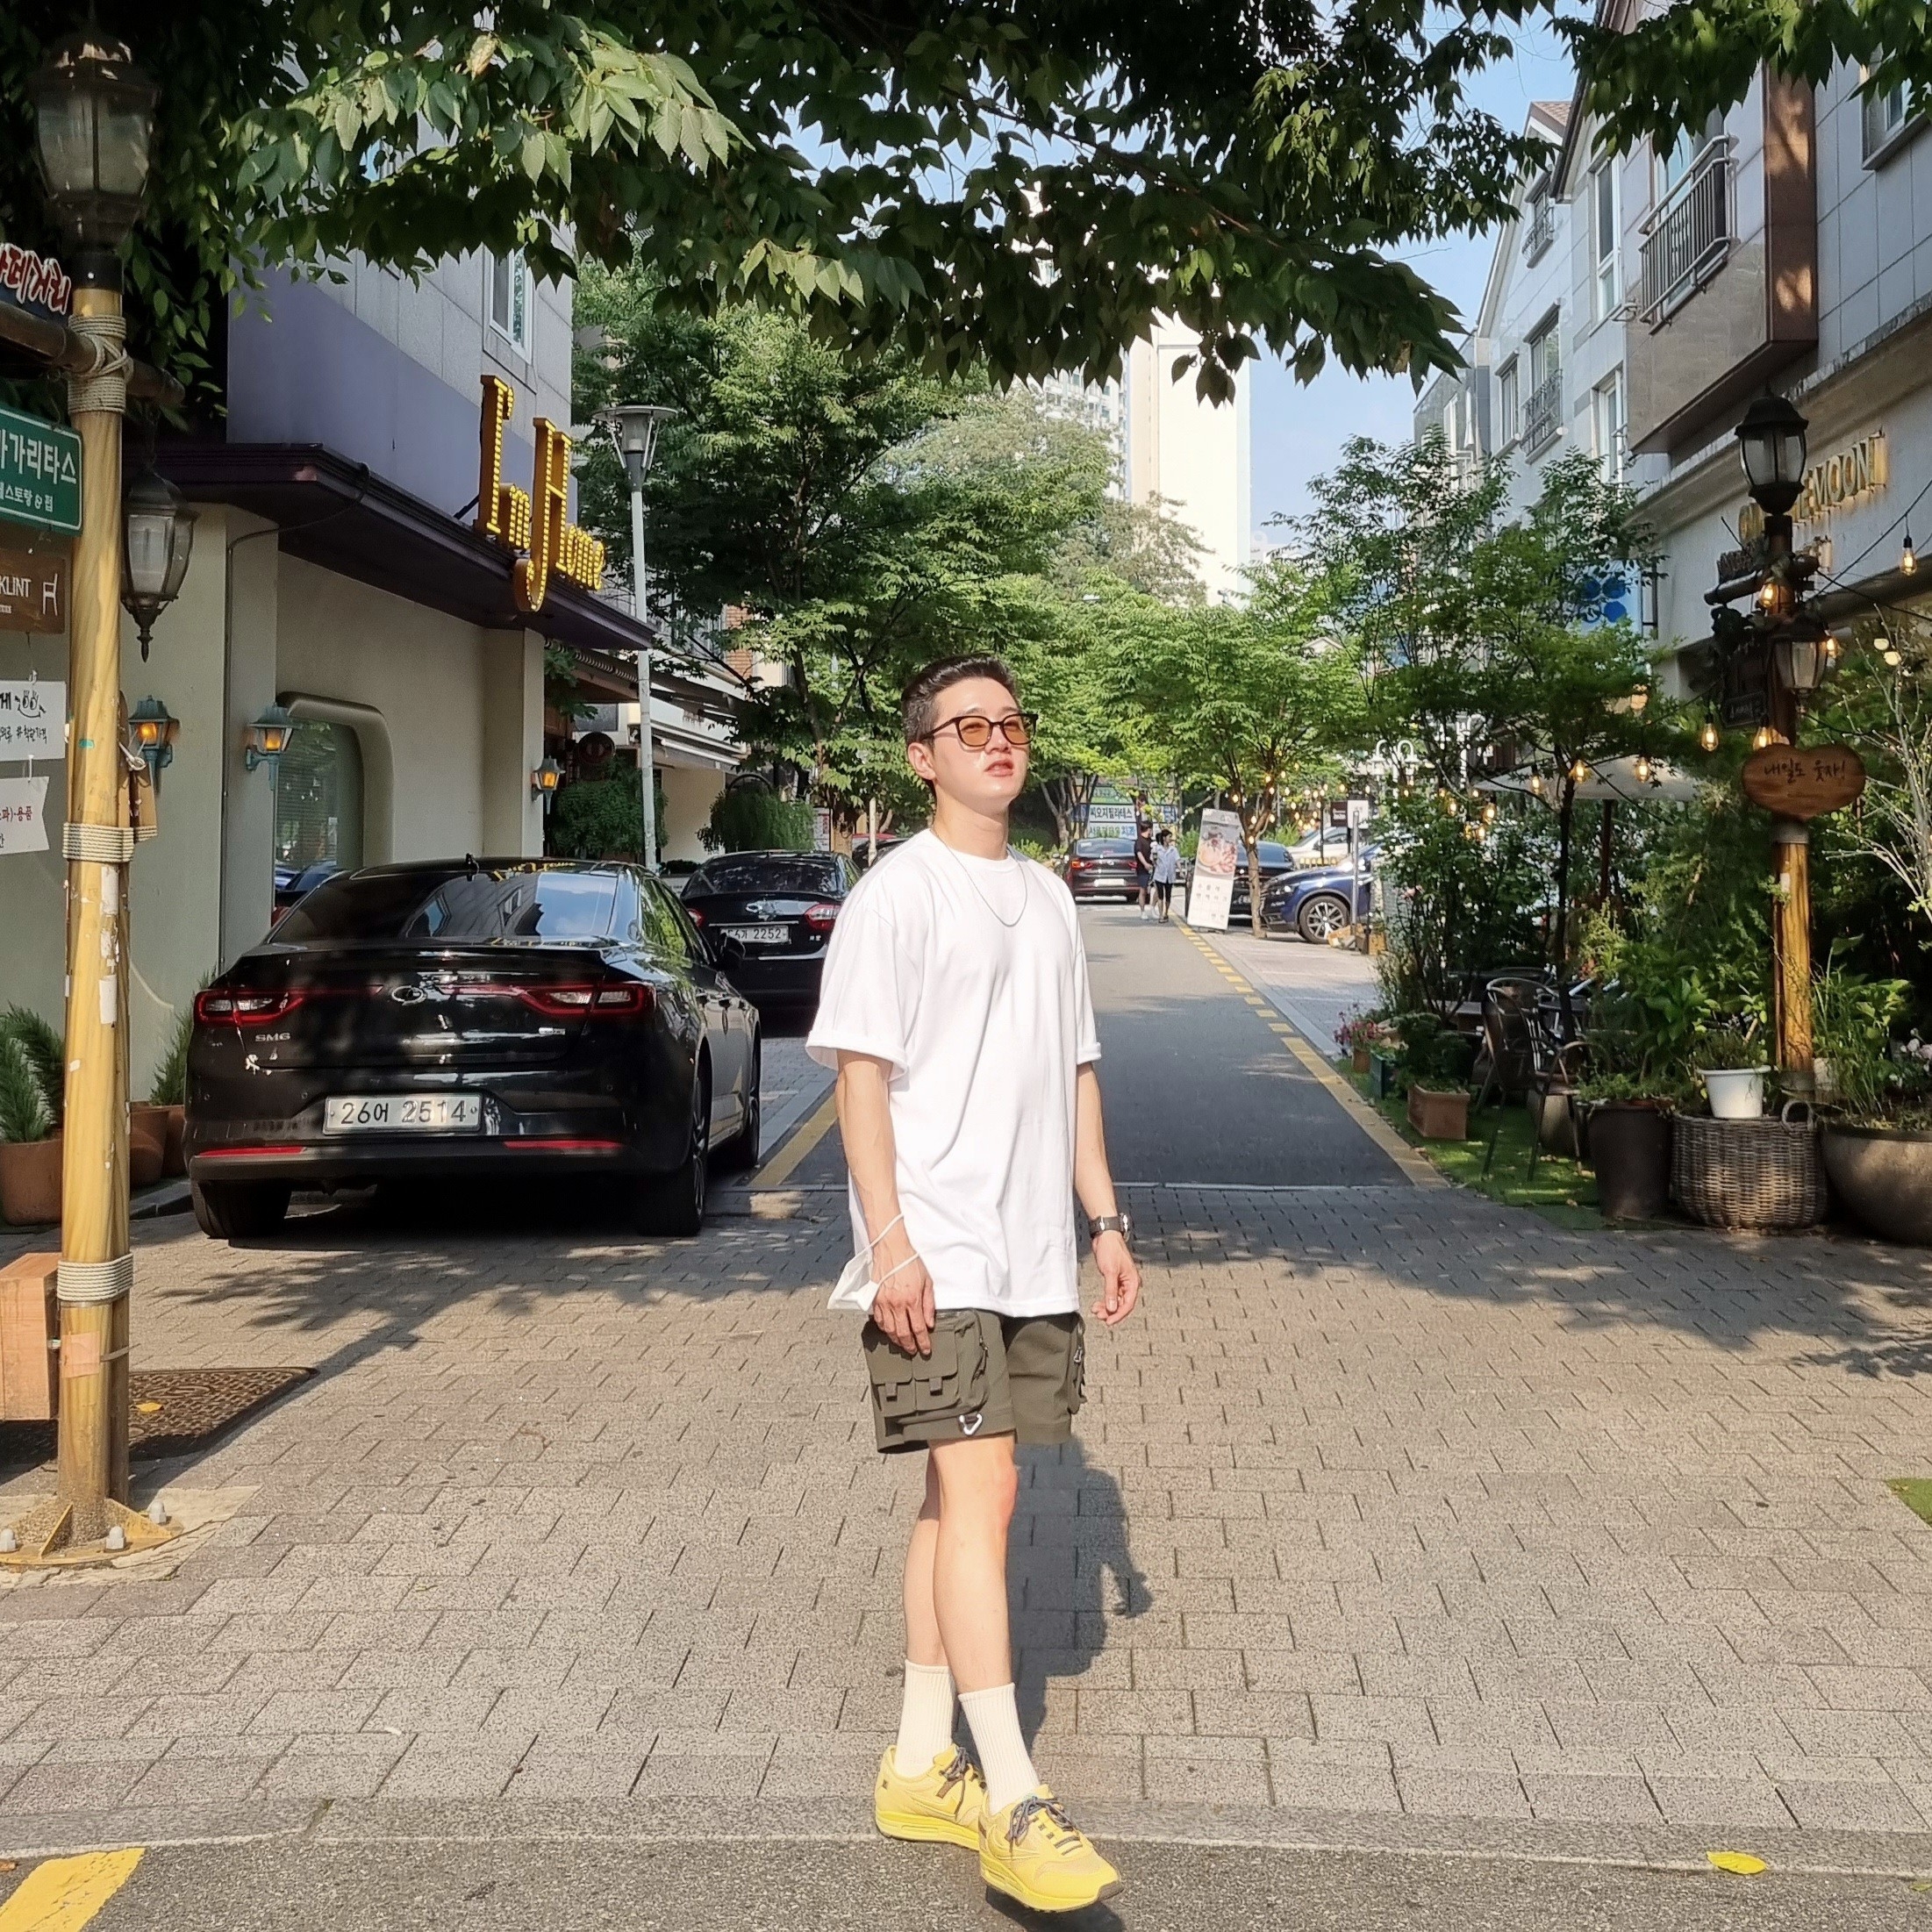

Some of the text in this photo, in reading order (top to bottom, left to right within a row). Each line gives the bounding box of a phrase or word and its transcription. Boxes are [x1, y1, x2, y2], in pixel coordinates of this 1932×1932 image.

[1764, 758, 1845, 784] 내일도 웃자!
[754, 927, 782, 939] 2252
[341, 1100, 467, 1124] 26어 2514
